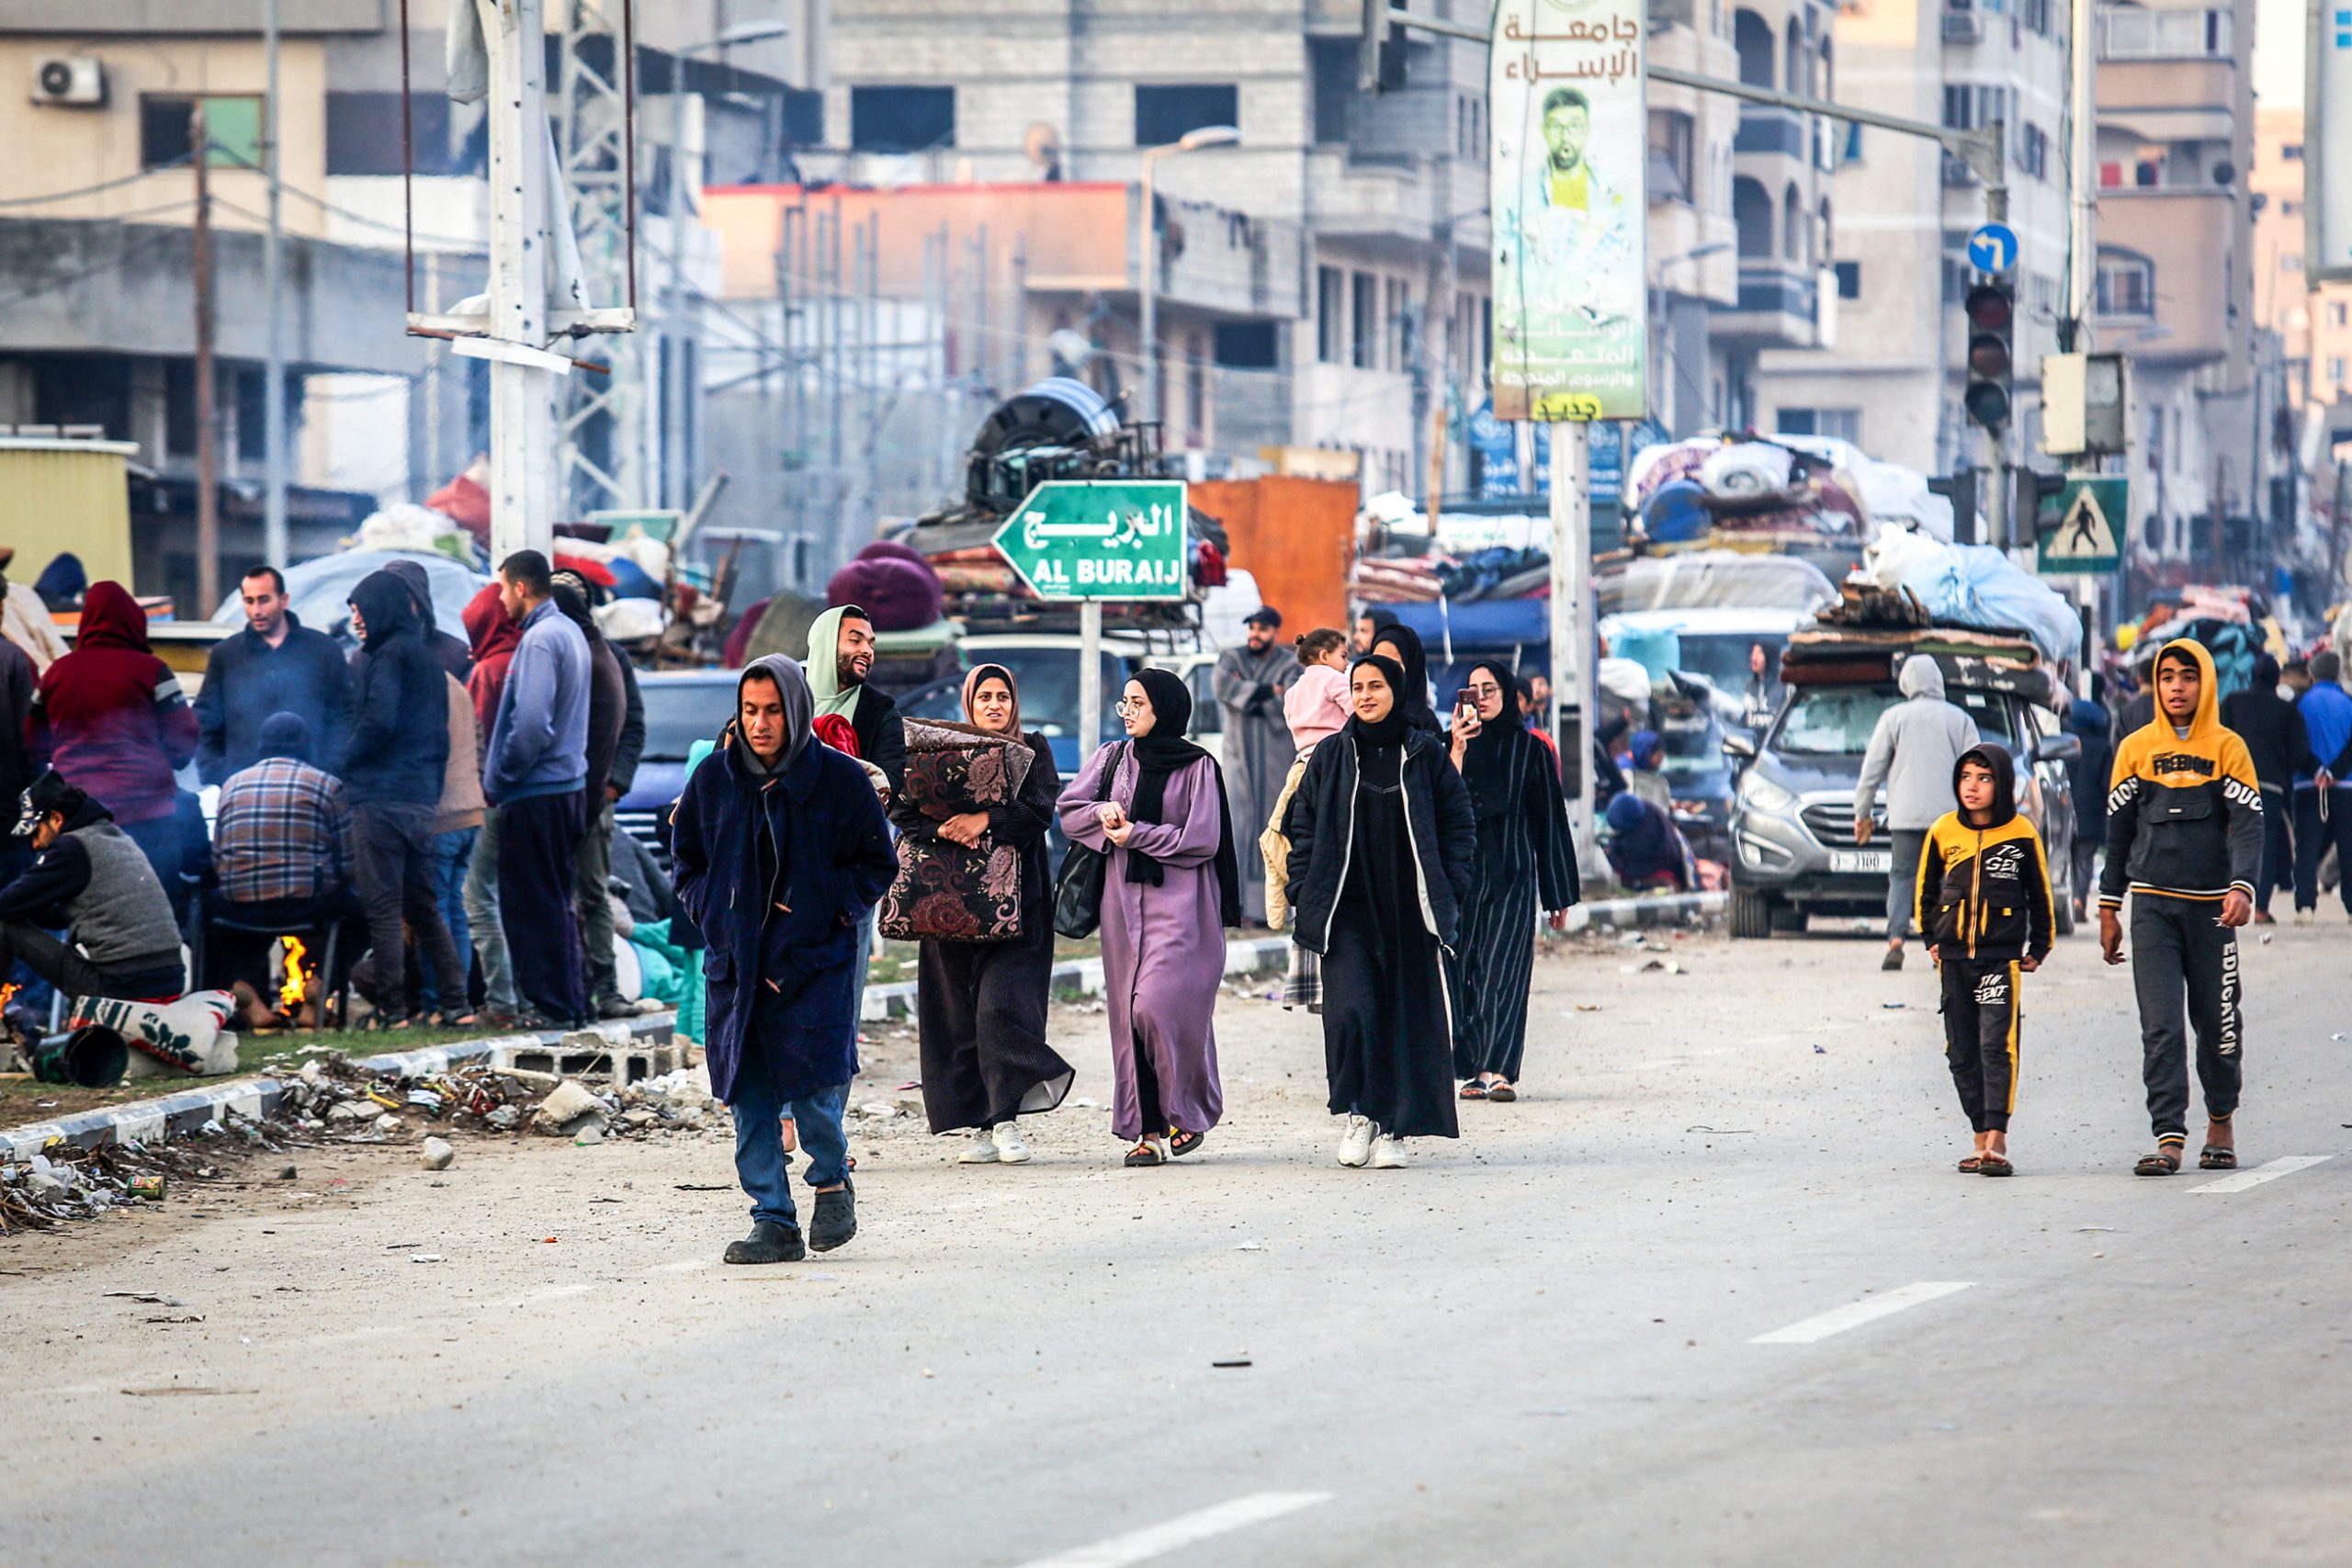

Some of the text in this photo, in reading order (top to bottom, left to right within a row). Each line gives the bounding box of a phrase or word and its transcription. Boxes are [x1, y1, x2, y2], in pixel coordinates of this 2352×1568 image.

[1023, 502, 1173, 550] البريج
[1032, 558, 1180, 584] AL BURAIJ
[2219, 941, 2237, 1056] EDUCATION
